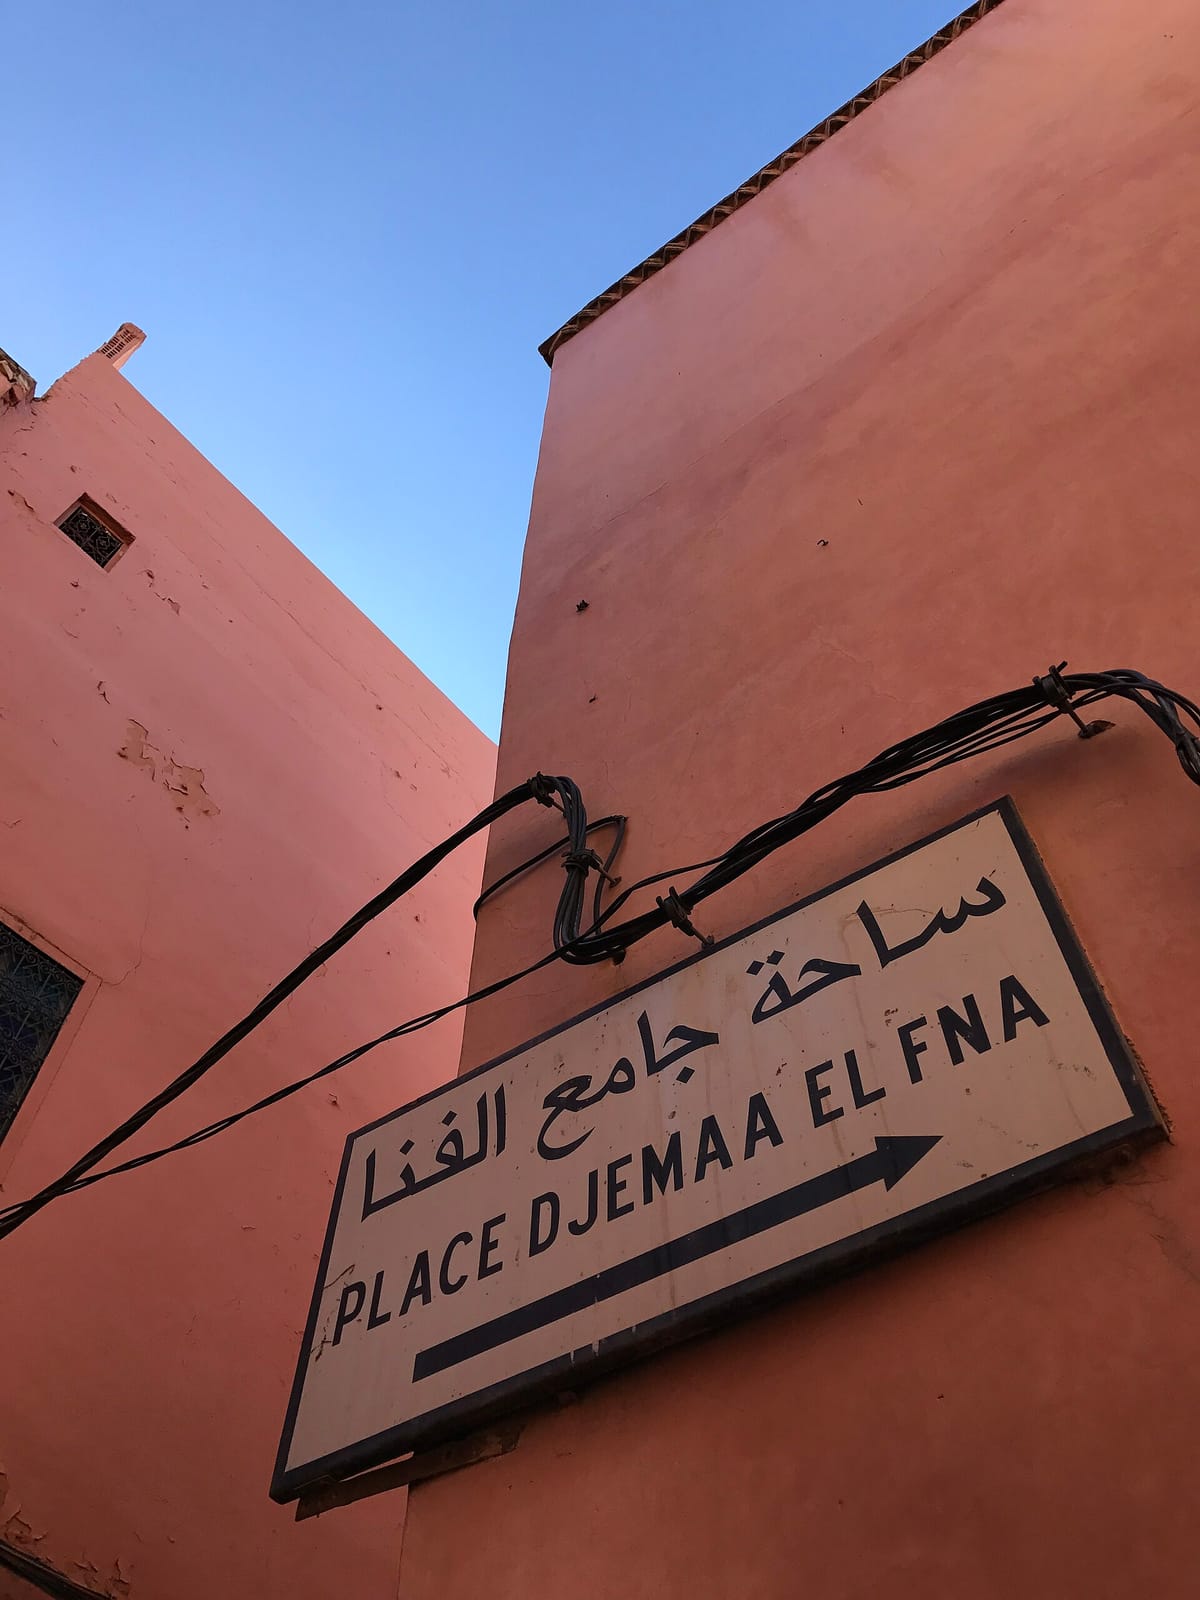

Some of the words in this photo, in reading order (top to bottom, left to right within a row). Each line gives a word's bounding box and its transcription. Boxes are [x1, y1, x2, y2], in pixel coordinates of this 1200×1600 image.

[745, 876, 1007, 1025] ساحة
[332, 1212, 507, 1347] PLACE
[528, 1091, 785, 1259] DJEMAA
[804, 1048, 887, 1129] EL
[896, 974, 1051, 1085] FNA
[360, 1081, 507, 1223] الفنا
[536, 1009, 720, 1163] جامع
